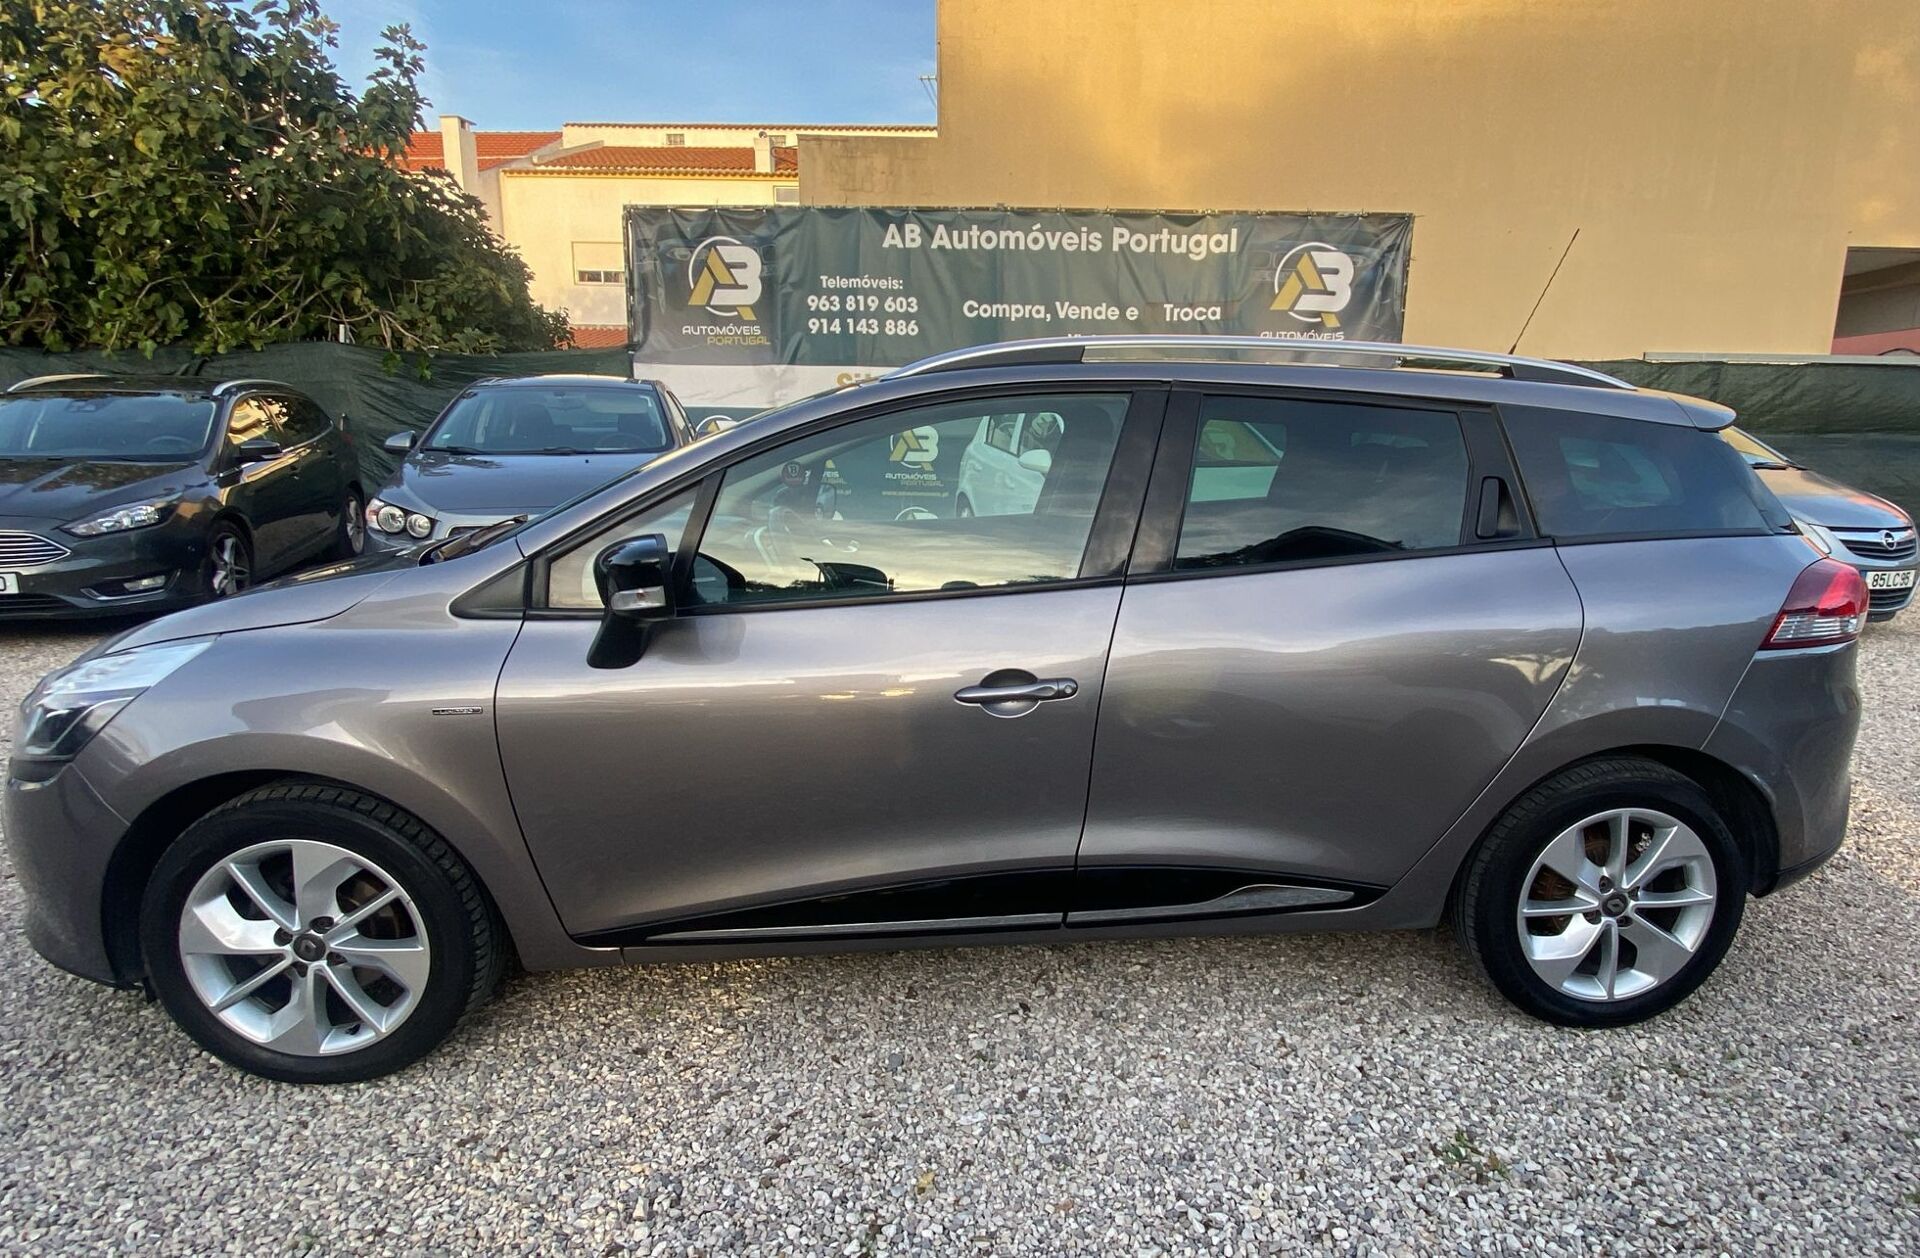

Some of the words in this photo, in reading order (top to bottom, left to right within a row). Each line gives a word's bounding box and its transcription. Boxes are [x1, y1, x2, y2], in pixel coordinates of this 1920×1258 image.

[882, 223, 922, 249] AB
[931, 223, 1103, 252] Automóveis
[1112, 227, 1239, 261] Portugal
[820, 274, 903, 290] Telemóveis:
[807, 295, 840, 312] 963
[846, 296, 879, 312] 819
[884, 296, 918, 313] 603
[962, 300, 1051, 322] Compra,
[1055, 301, 1119, 321] Vende
[1125, 306, 1139, 321] e
[1162, 303, 1221, 322] Troca
[682, 323, 761, 335] AUTOMÓVEIS
[808, 319, 840, 335] 914
[845, 319, 879, 335] 143
[884, 320, 919, 336] 886
[707, 336, 771, 345] PORTUGAL
